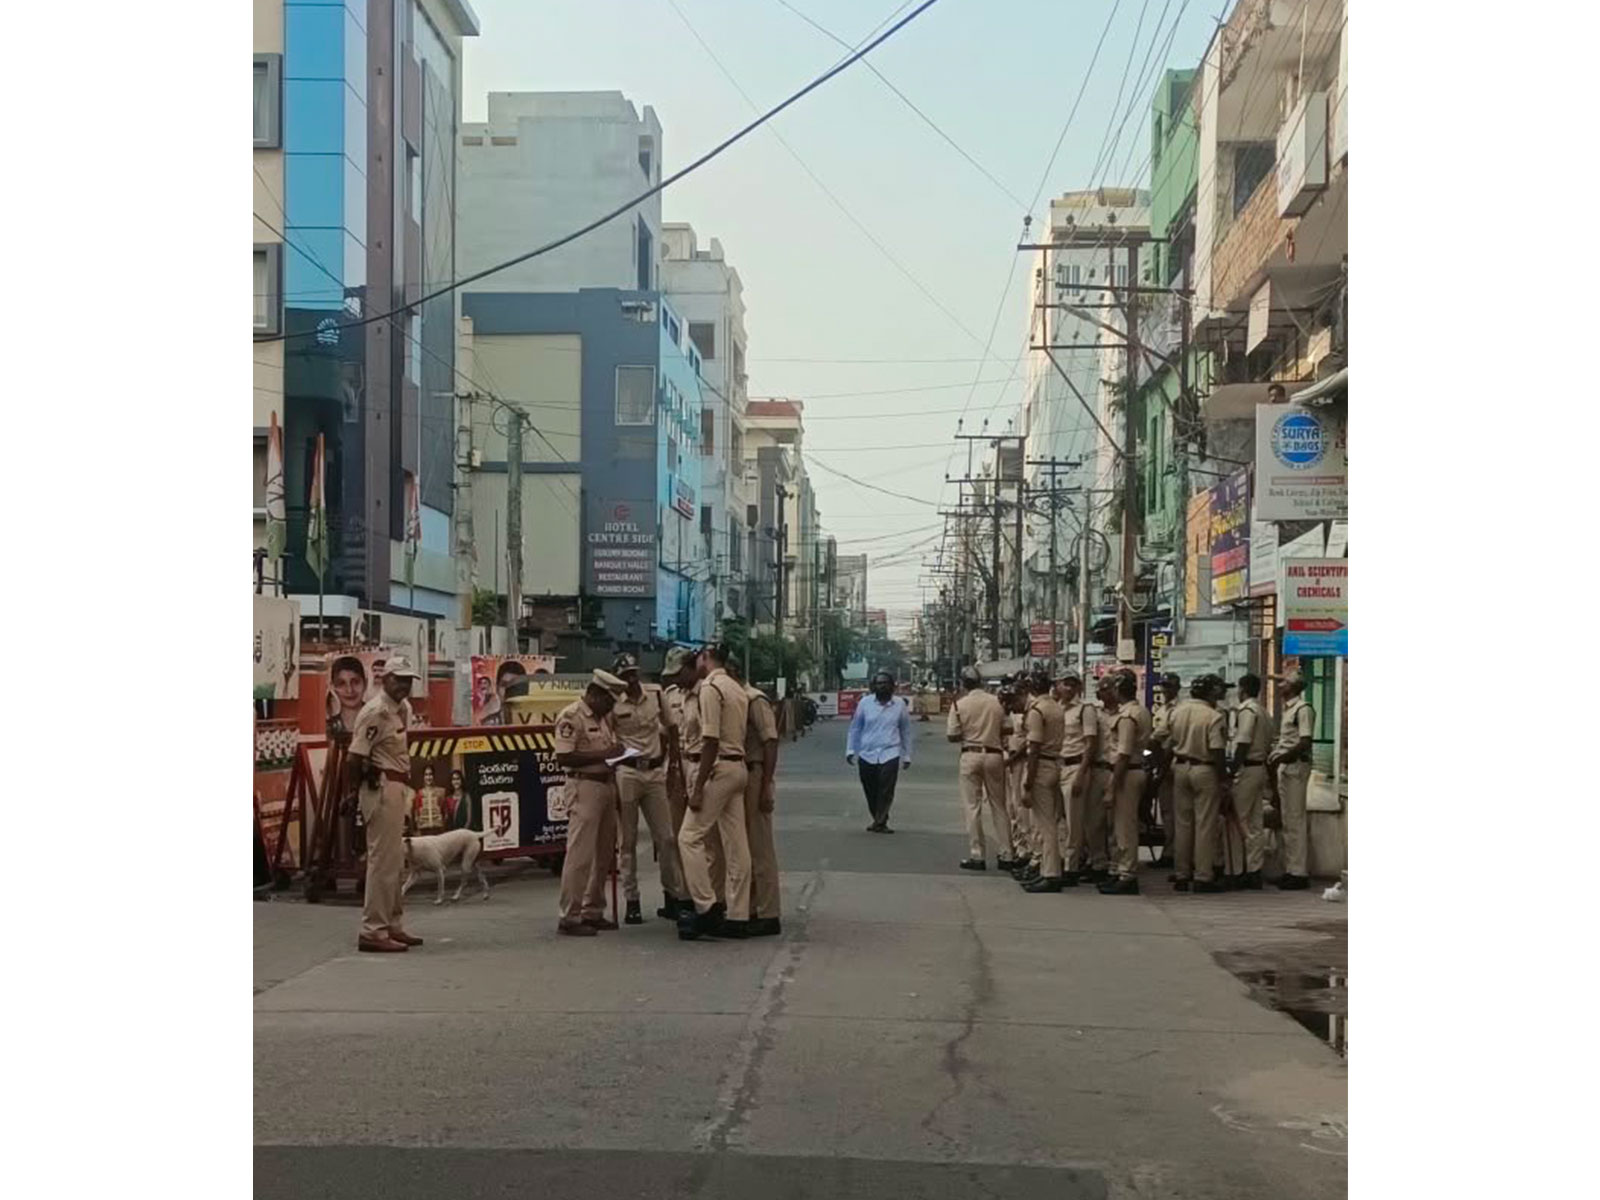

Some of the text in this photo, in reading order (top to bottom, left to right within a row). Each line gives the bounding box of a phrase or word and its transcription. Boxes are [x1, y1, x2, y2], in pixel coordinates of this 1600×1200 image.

[1281, 428, 1320, 439] SURYA
[1293, 441, 1320, 451] BAGS
[604, 522, 639, 532] HOTEL
[588, 533, 654, 543] CENTRE SIDE
[594, 561, 648, 570] BANQUET HALLS
[1287, 566, 1348, 577] ANIL SCIENTIFI
[598, 573, 643, 581] RESTAURANT
[597, 585, 645, 593] BOARD ROOM
[1297, 587, 1341, 598] CHEMICALS
[463, 740, 484, 750] STOP
[539, 762, 560, 772] POL
